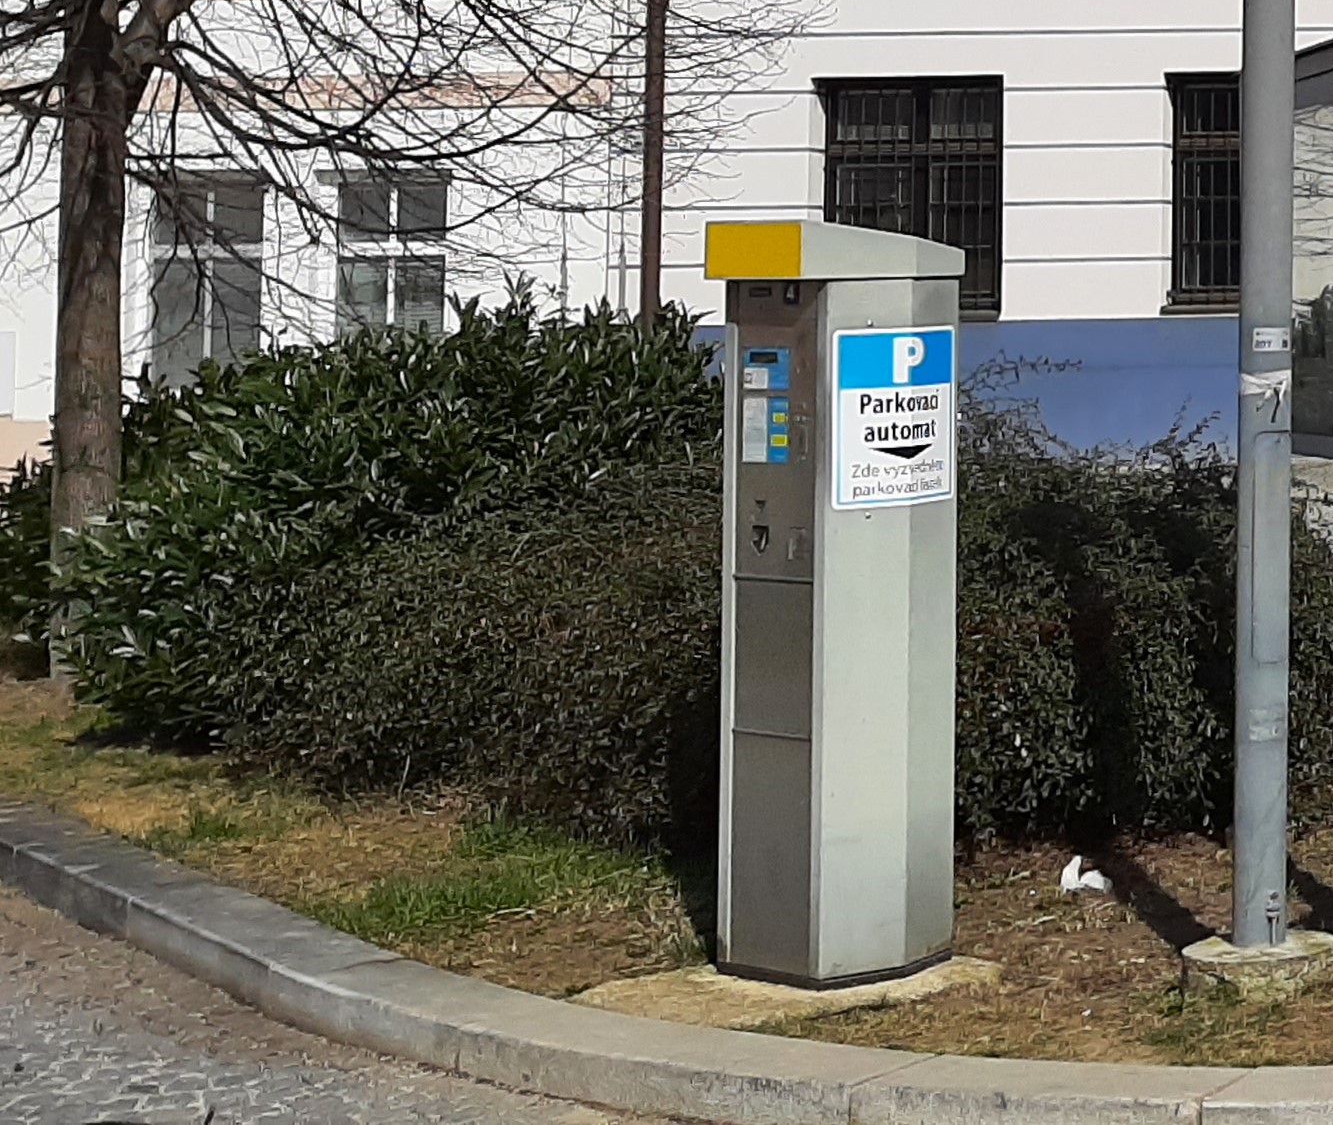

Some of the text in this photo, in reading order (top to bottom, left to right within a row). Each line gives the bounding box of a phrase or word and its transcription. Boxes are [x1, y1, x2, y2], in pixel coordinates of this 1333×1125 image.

[892, 336, 925, 384] P
[864, 419, 936, 442] automat
[851, 463, 880, 478] Zde
